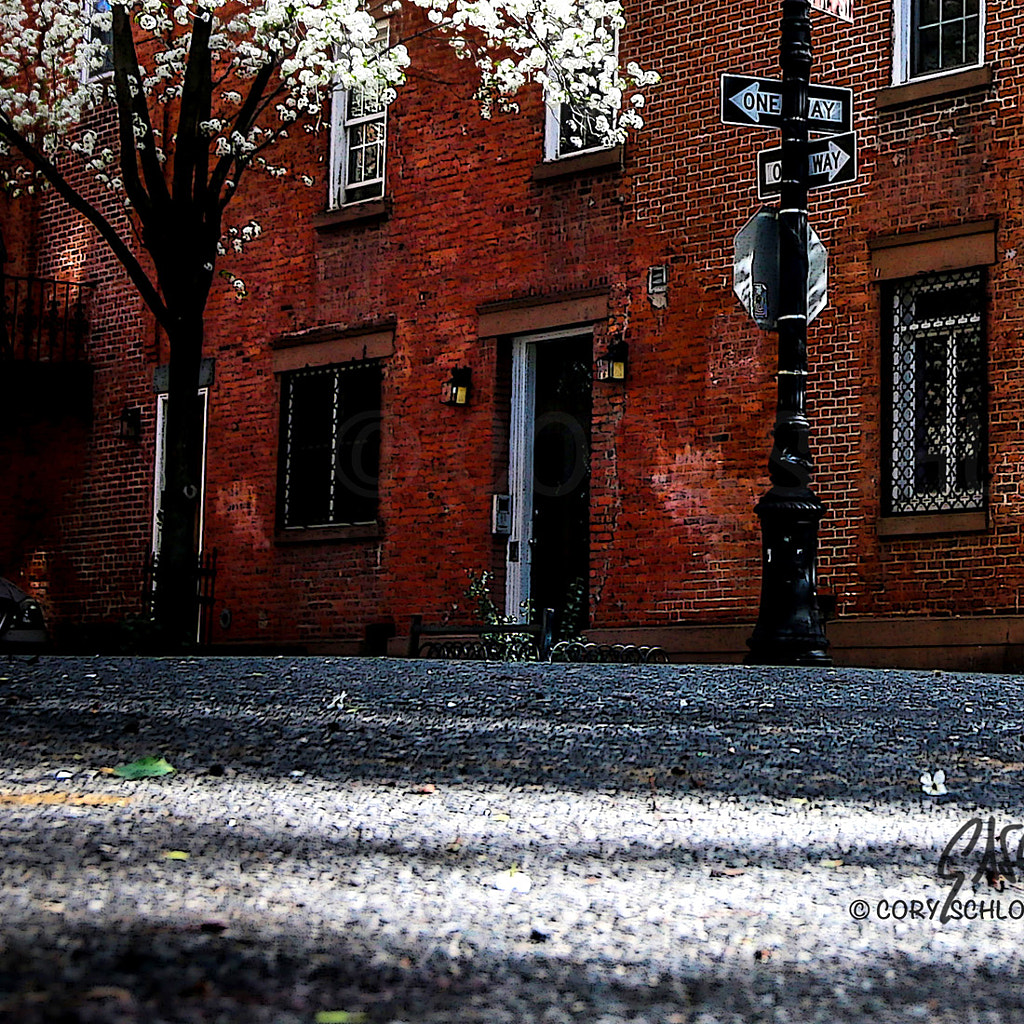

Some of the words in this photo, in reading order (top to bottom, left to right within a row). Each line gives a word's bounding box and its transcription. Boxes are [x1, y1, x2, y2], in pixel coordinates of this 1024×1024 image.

[743, 93, 780, 114] ONE
[811, 101, 834, 118] AY
[813, 151, 841, 173] WAY
